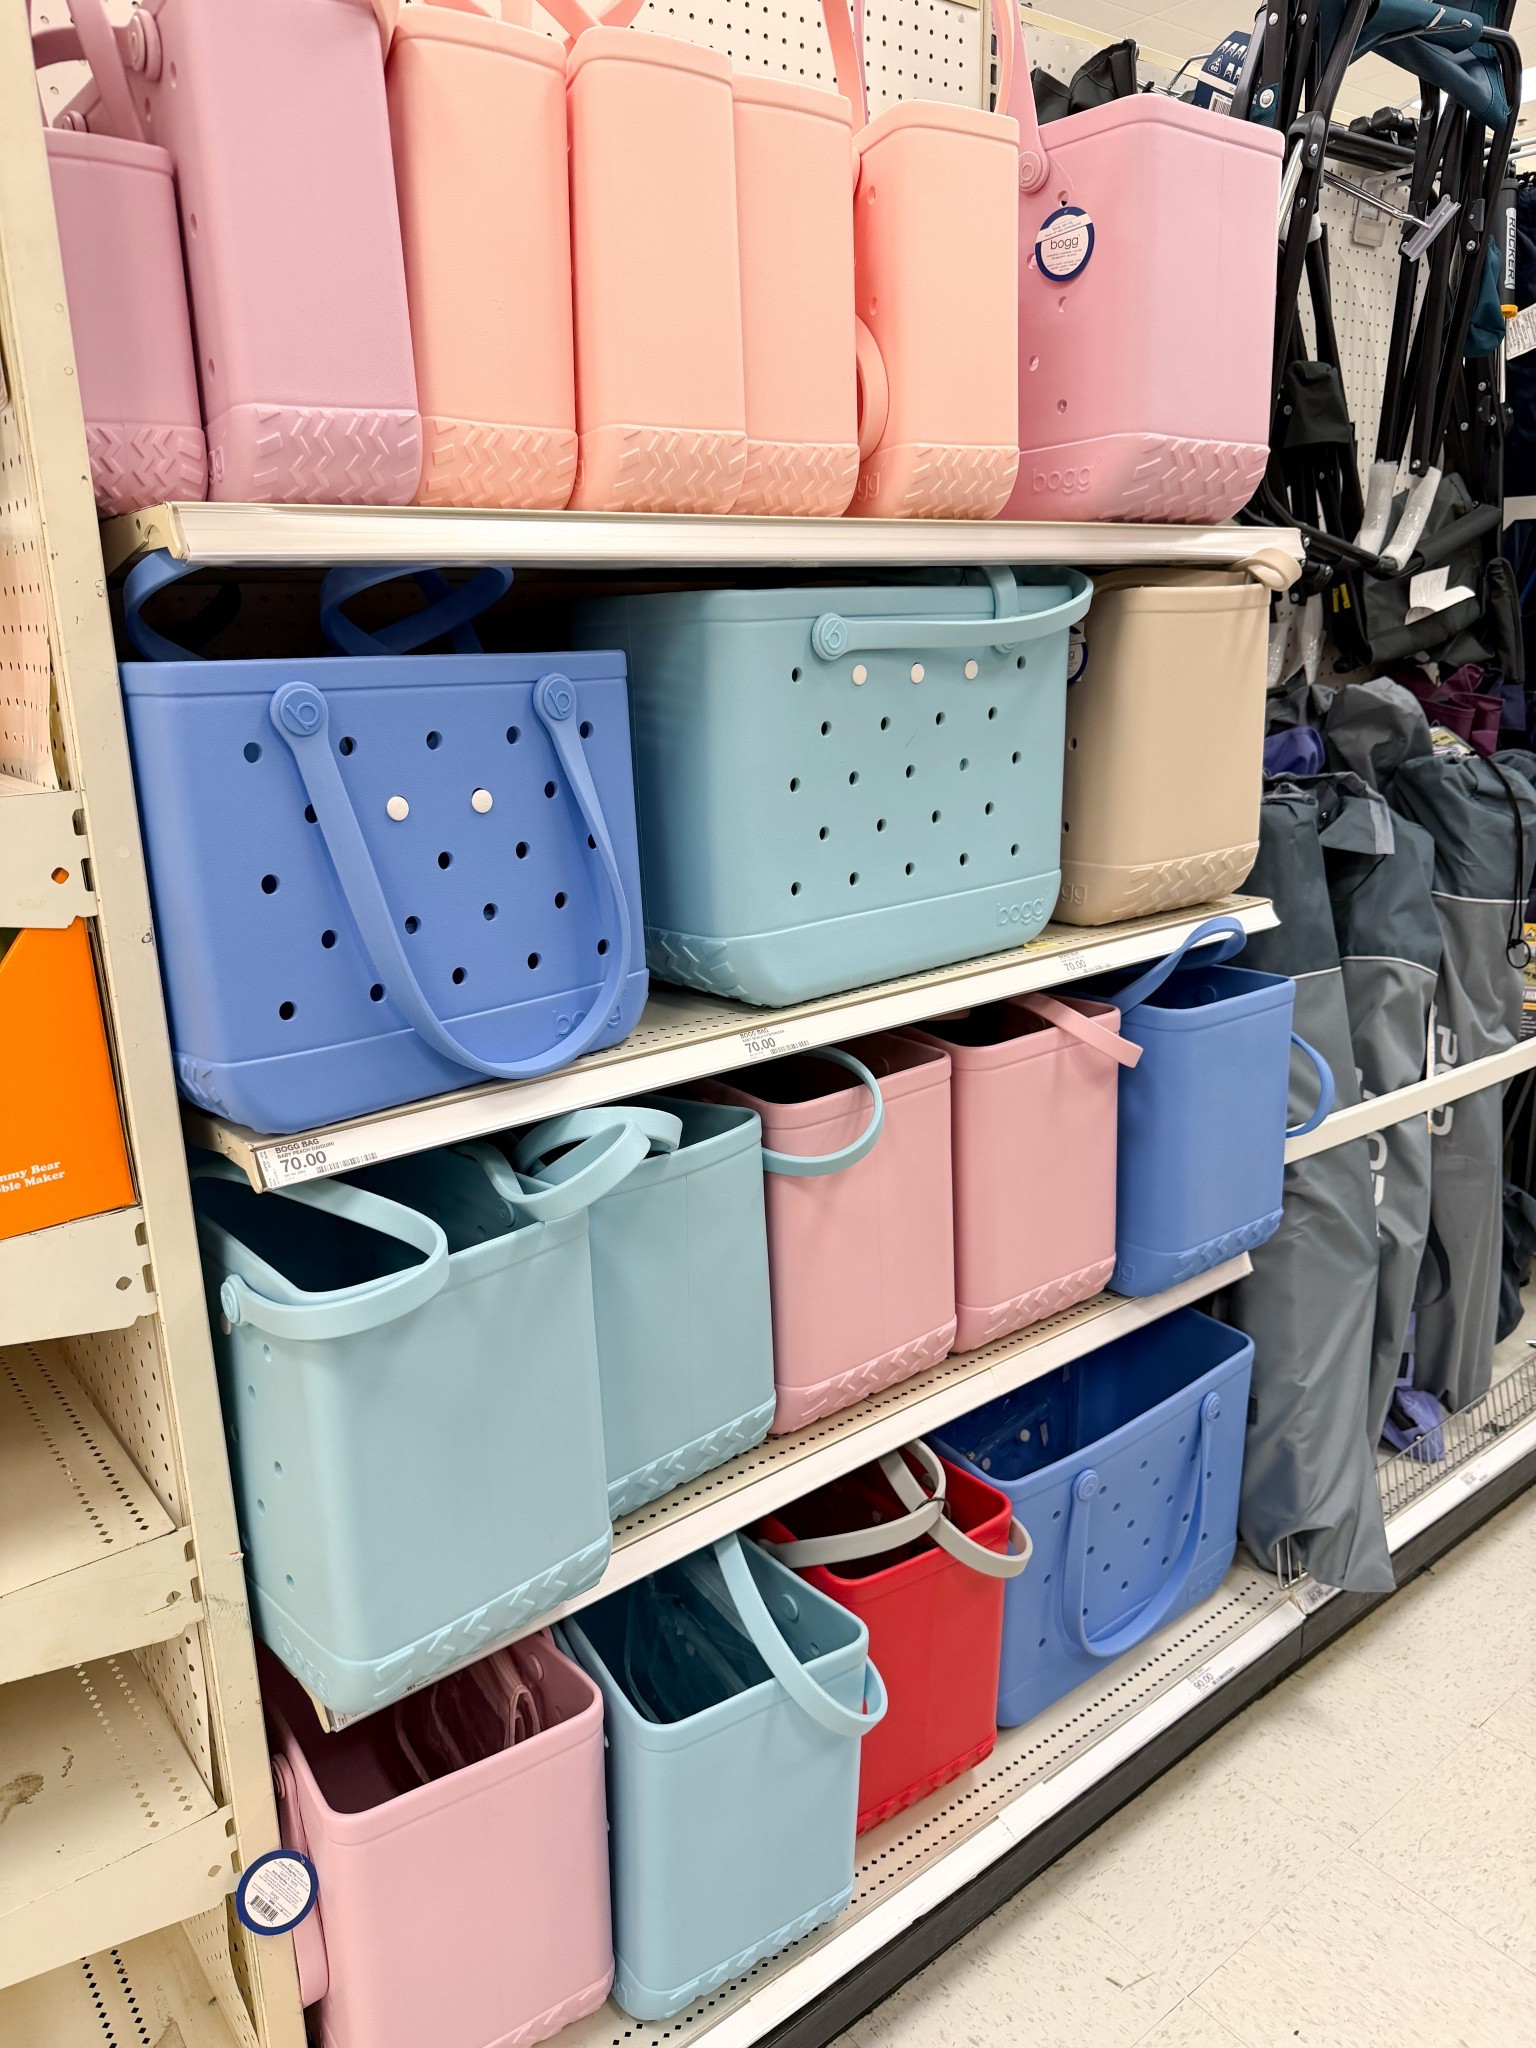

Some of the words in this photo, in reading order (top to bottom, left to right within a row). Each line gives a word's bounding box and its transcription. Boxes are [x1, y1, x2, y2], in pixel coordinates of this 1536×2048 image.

[1050, 236, 1079, 250] bogg
[1508, 216, 1516, 281] ROCKER
[1033, 465, 1092, 495] bogg
[997, 898, 1043, 926] bogg
[1063, 959, 1087, 971] 70.00
[740, 1030, 757, 1039] BOGG
[744, 1037, 776, 1053] 70.00
[275, 1143, 300, 1154] BOGG
[302, 1139, 319, 1148] BAG
[292, 1147, 311, 1155] PEACH
[31, 1162, 60, 1174] Bear
[279, 1151, 326, 1172] 70.00
[0, 1182, 21, 1192] ble
[24, 1171, 65, 1187] Maker
